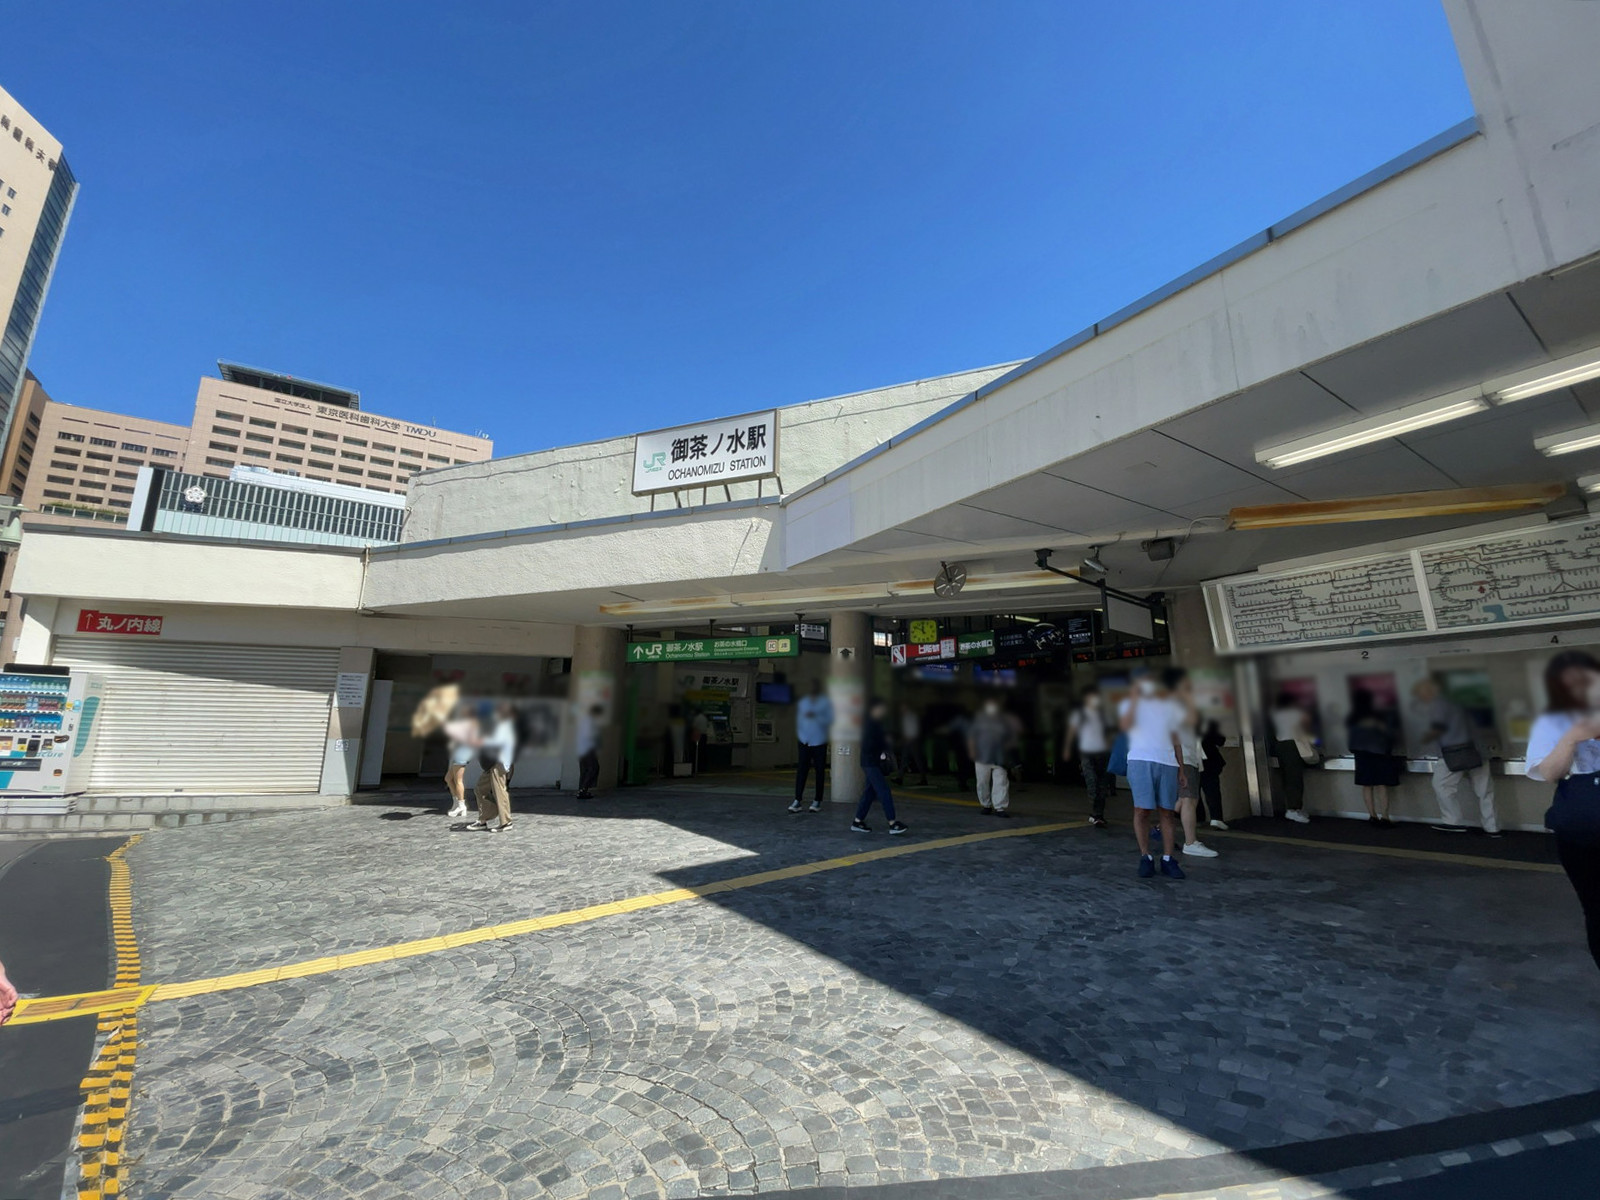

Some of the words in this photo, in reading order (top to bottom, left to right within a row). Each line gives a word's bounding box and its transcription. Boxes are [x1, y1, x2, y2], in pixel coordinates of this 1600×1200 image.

[316, 405, 401, 431] 東京医科歯科大学
[405, 424, 437, 438] TMDU
[671, 424, 766, 463] 御茶ノ水駅
[643, 452, 666, 468] JR
[668, 462, 725, 481] OCHANOMIZU
[730, 455, 767, 472] STATION
[97, 615, 161, 633] 丸ノ内線
[645, 643, 663, 655] JR
[1361, 650, 1369, 660] 2
